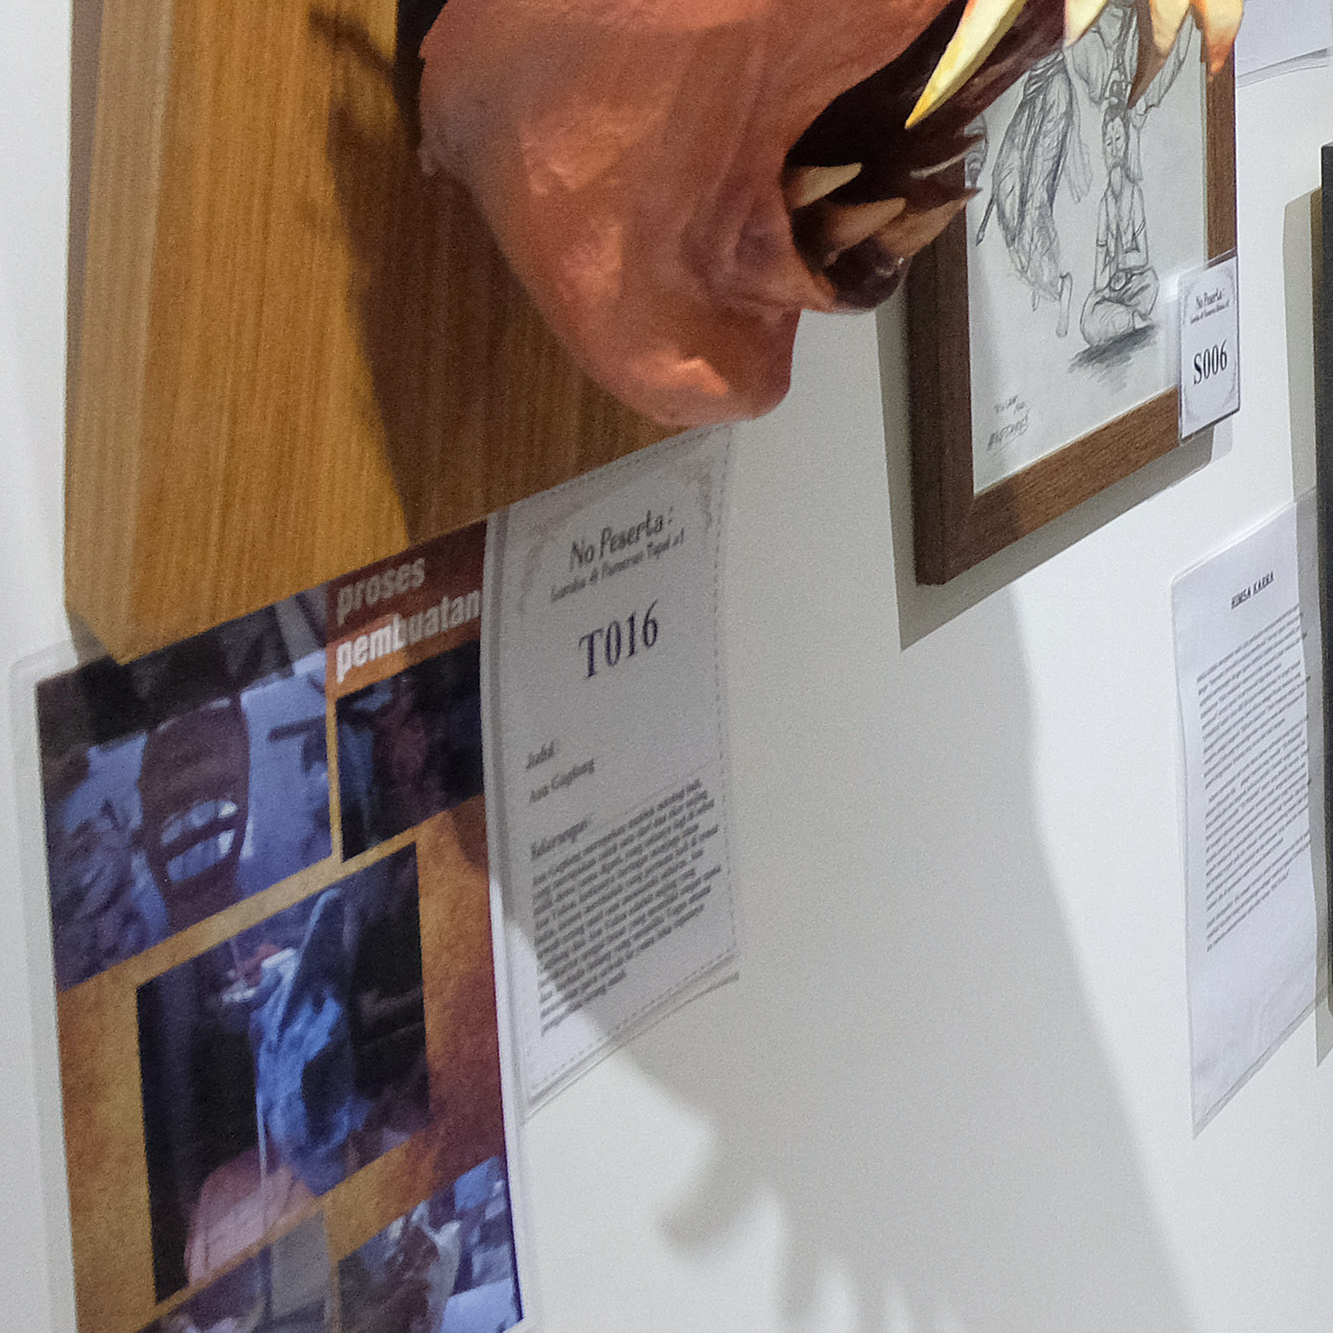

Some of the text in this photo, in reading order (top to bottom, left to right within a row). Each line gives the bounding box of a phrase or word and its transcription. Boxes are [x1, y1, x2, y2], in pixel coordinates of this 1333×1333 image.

[1193, 338, 1228, 386] S006
[569, 538, 595, 573] No
[599, 509, 664, 559] Peserta
[337, 557, 426, 627] proses
[335, 589, 483, 684] pembuatan
[577, 598, 659, 680] T016
